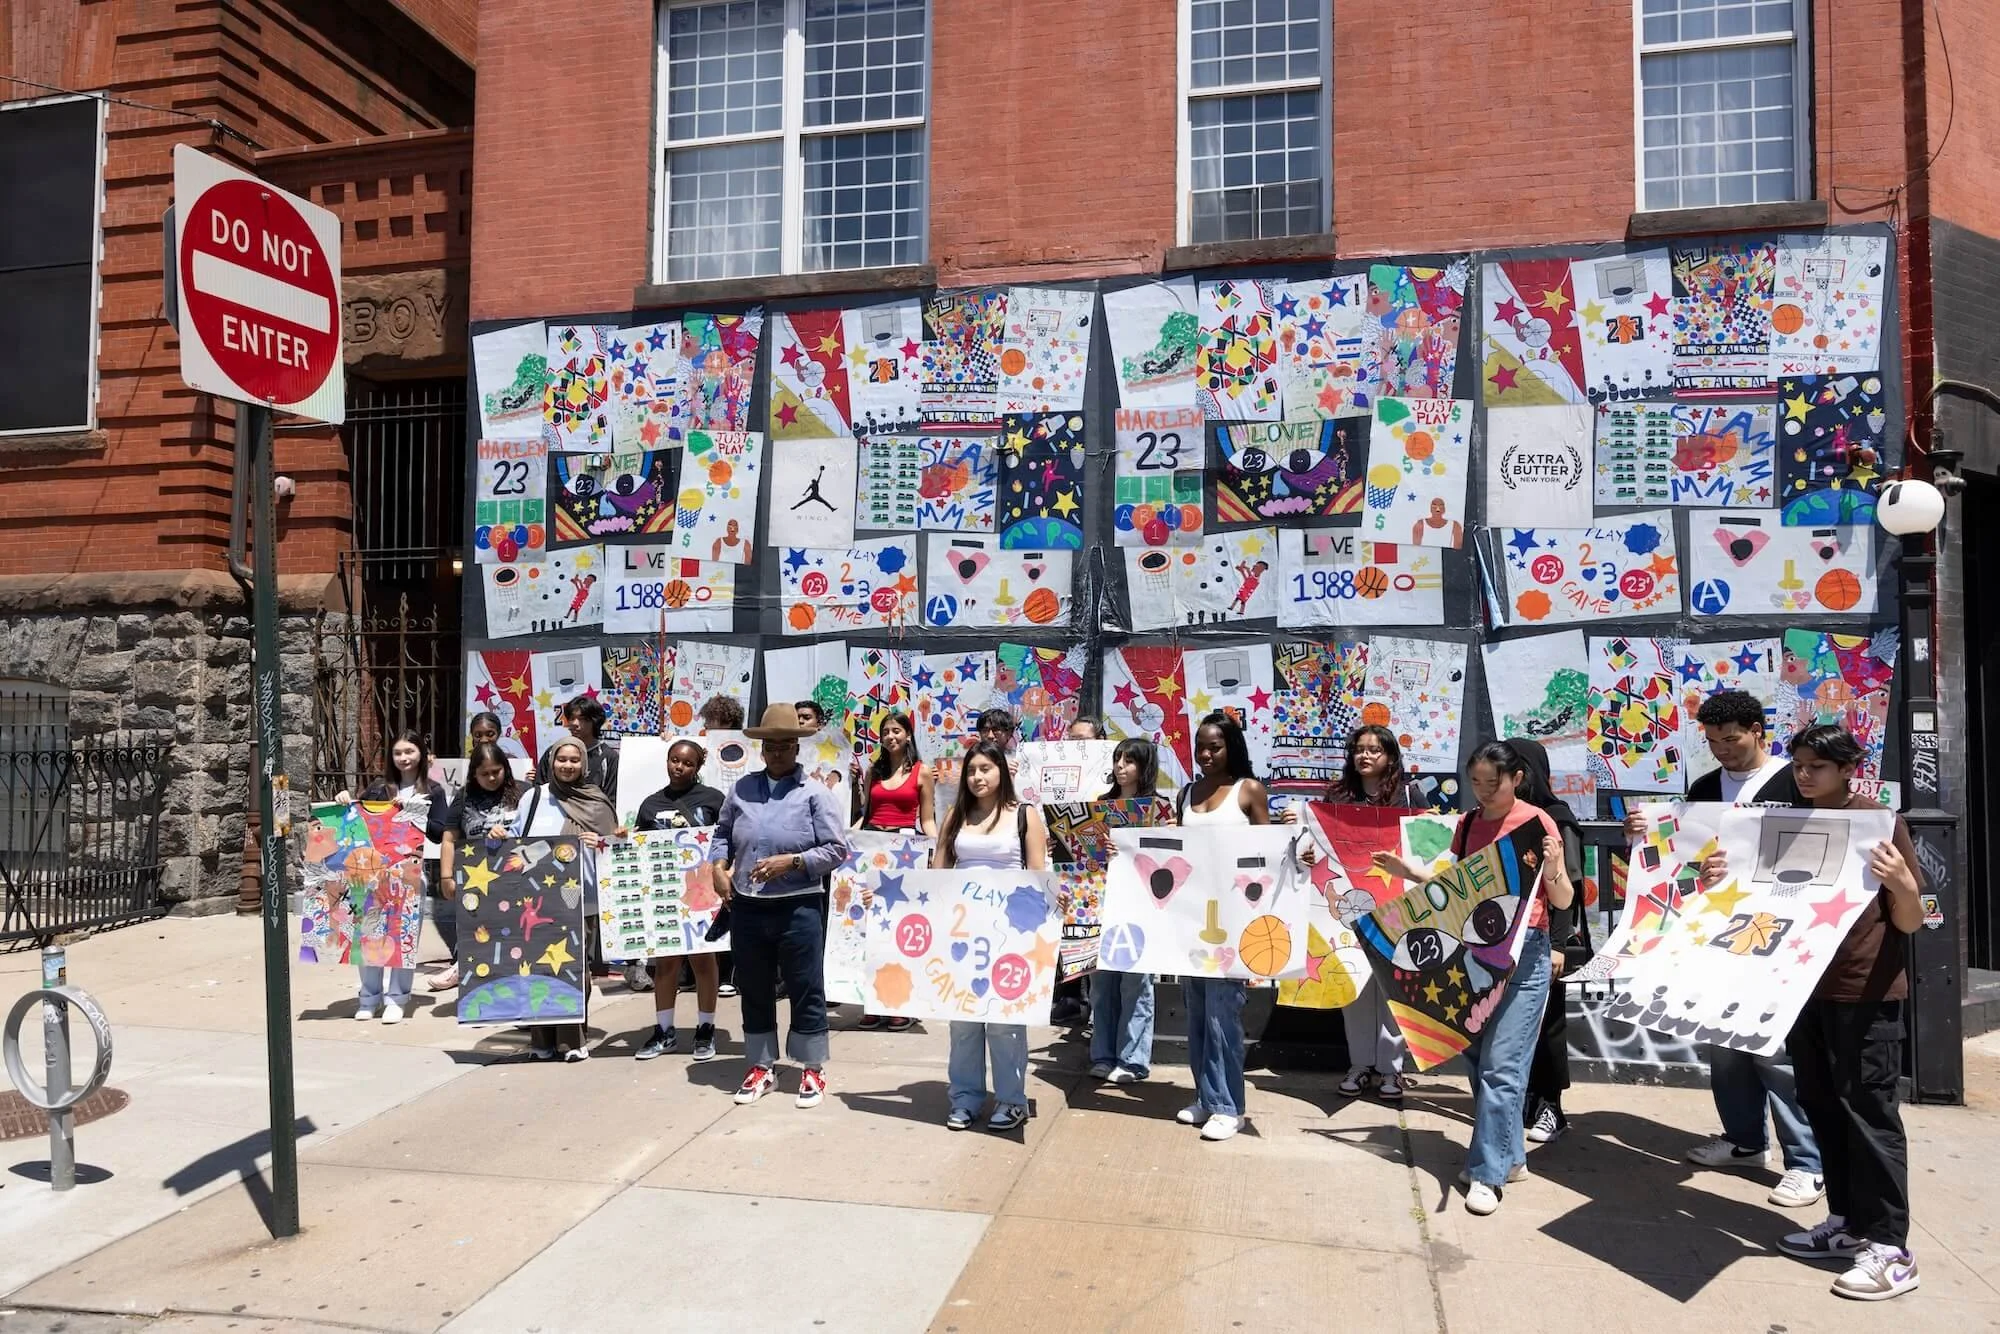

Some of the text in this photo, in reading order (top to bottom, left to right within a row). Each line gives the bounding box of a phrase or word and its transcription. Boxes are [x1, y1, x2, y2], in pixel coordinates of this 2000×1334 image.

[211, 208, 312, 278] DO NOT
[222, 313, 310, 371] ENTER
[1412, 399, 1456, 413] JUST
[1116, 408, 1204, 431] HARLEM
[1416, 412, 1451, 425] PLAY
[715, 432, 750, 444] JUST
[1251, 420, 1315, 443] LOVE
[479, 439, 548, 459] HARLEM
[718, 443, 746, 455] PLAY
[1135, 432, 1181, 471] 23
[1517, 454, 1565, 464] EXTRA
[1243, 453, 1265, 469] 23
[1513, 465, 1569, 475] BUTTER
[492, 460, 529, 496] 23
[576, 479, 595, 494] 23
[528, 500, 537, 522] 5
[1119, 510, 1133, 523] A
[1184, 509, 1195, 528] D
[479, 530, 490, 542] A
[530, 528, 540, 545] D
[1151, 523, 1160, 540] 1
[503, 542, 511, 557] 1
[615, 582, 665, 611] 1988
[1293, 569, 1356, 602] 1988
[1699, 579, 1726, 608] A
[931, 594, 954, 621] A
[1561, 581, 1612, 614] GAME
[1550, 774, 1597, 796] LEM
[1848, 781, 1885, 795] UST
[962, 881, 1008, 908] PLAY
[1404, 854, 1496, 924] LOVE
[949, 903, 970, 938] 2
[1107, 922, 1140, 962] A
[1709, 911, 1795, 958] 23
[973, 936, 991, 971] 3
[1410, 935, 1443, 966] 23
[925, 957, 979, 1014] GAME
